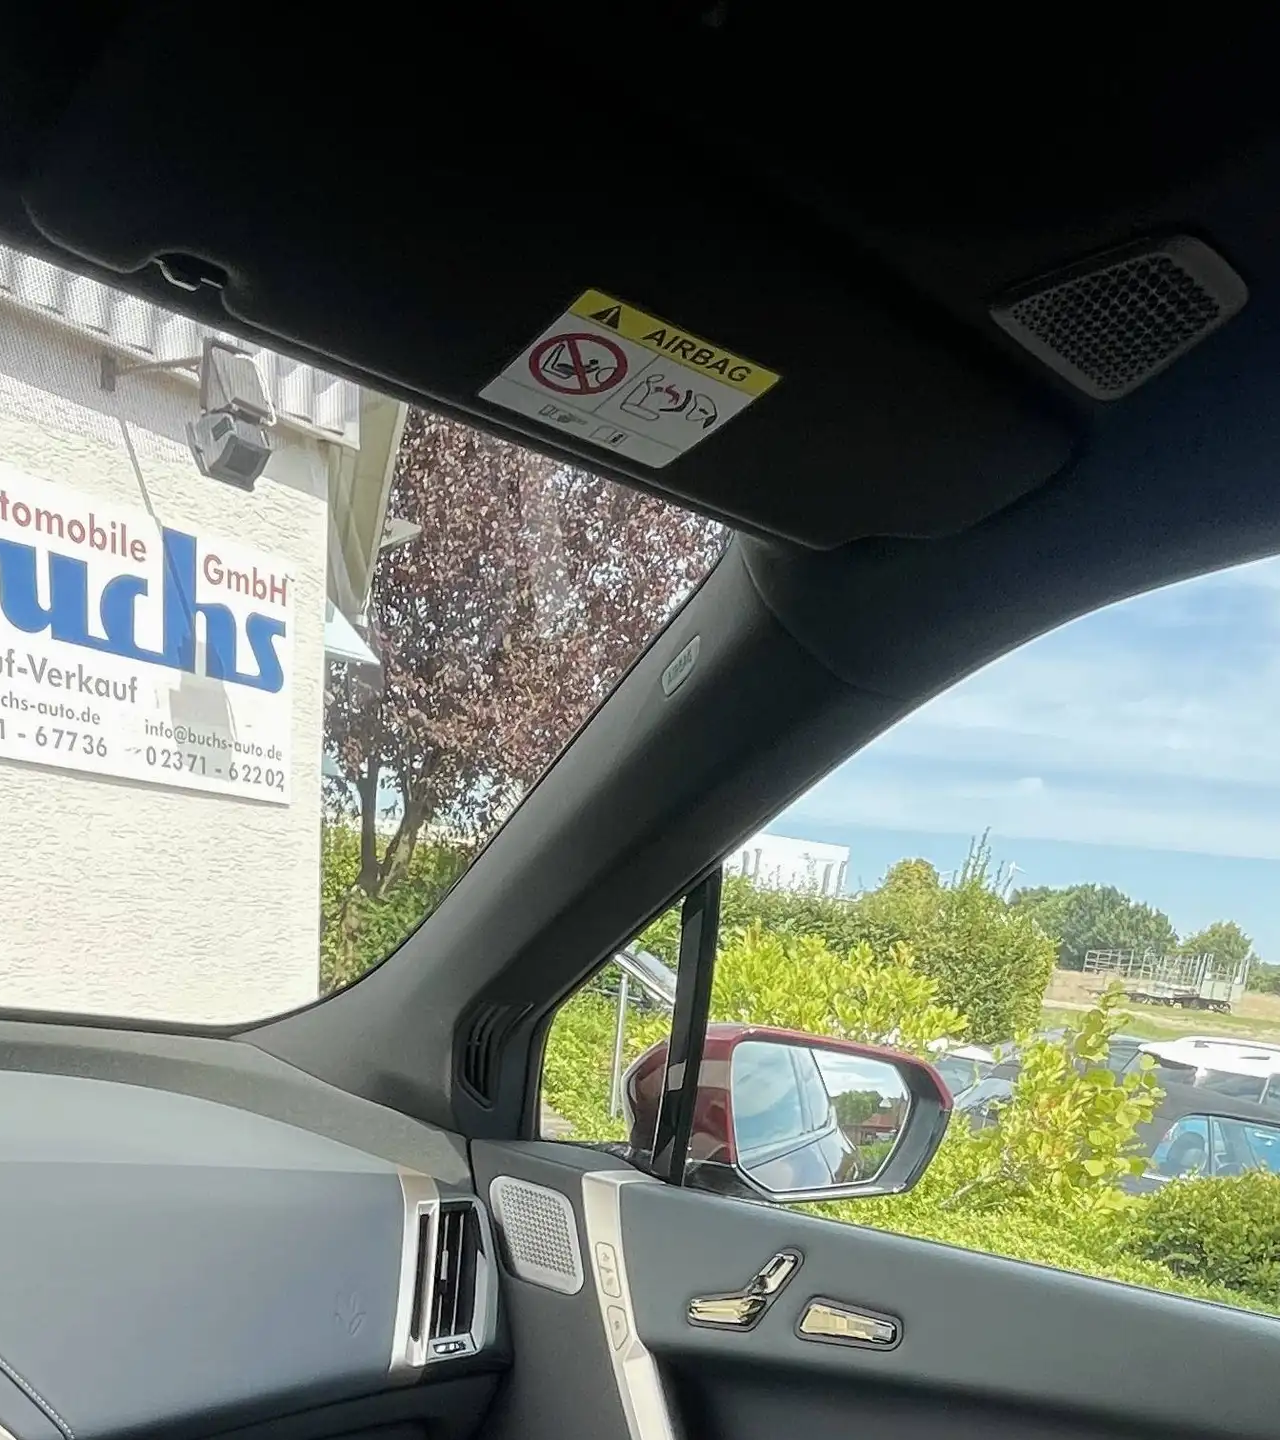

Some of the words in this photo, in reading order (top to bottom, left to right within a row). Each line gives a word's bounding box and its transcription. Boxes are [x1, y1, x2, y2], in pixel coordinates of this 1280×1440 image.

[641, 329, 752, 382] AIRBAG
[203, 553, 288, 607] GmbH
[145, 718, 283, 761] info@buchs-auto.de
